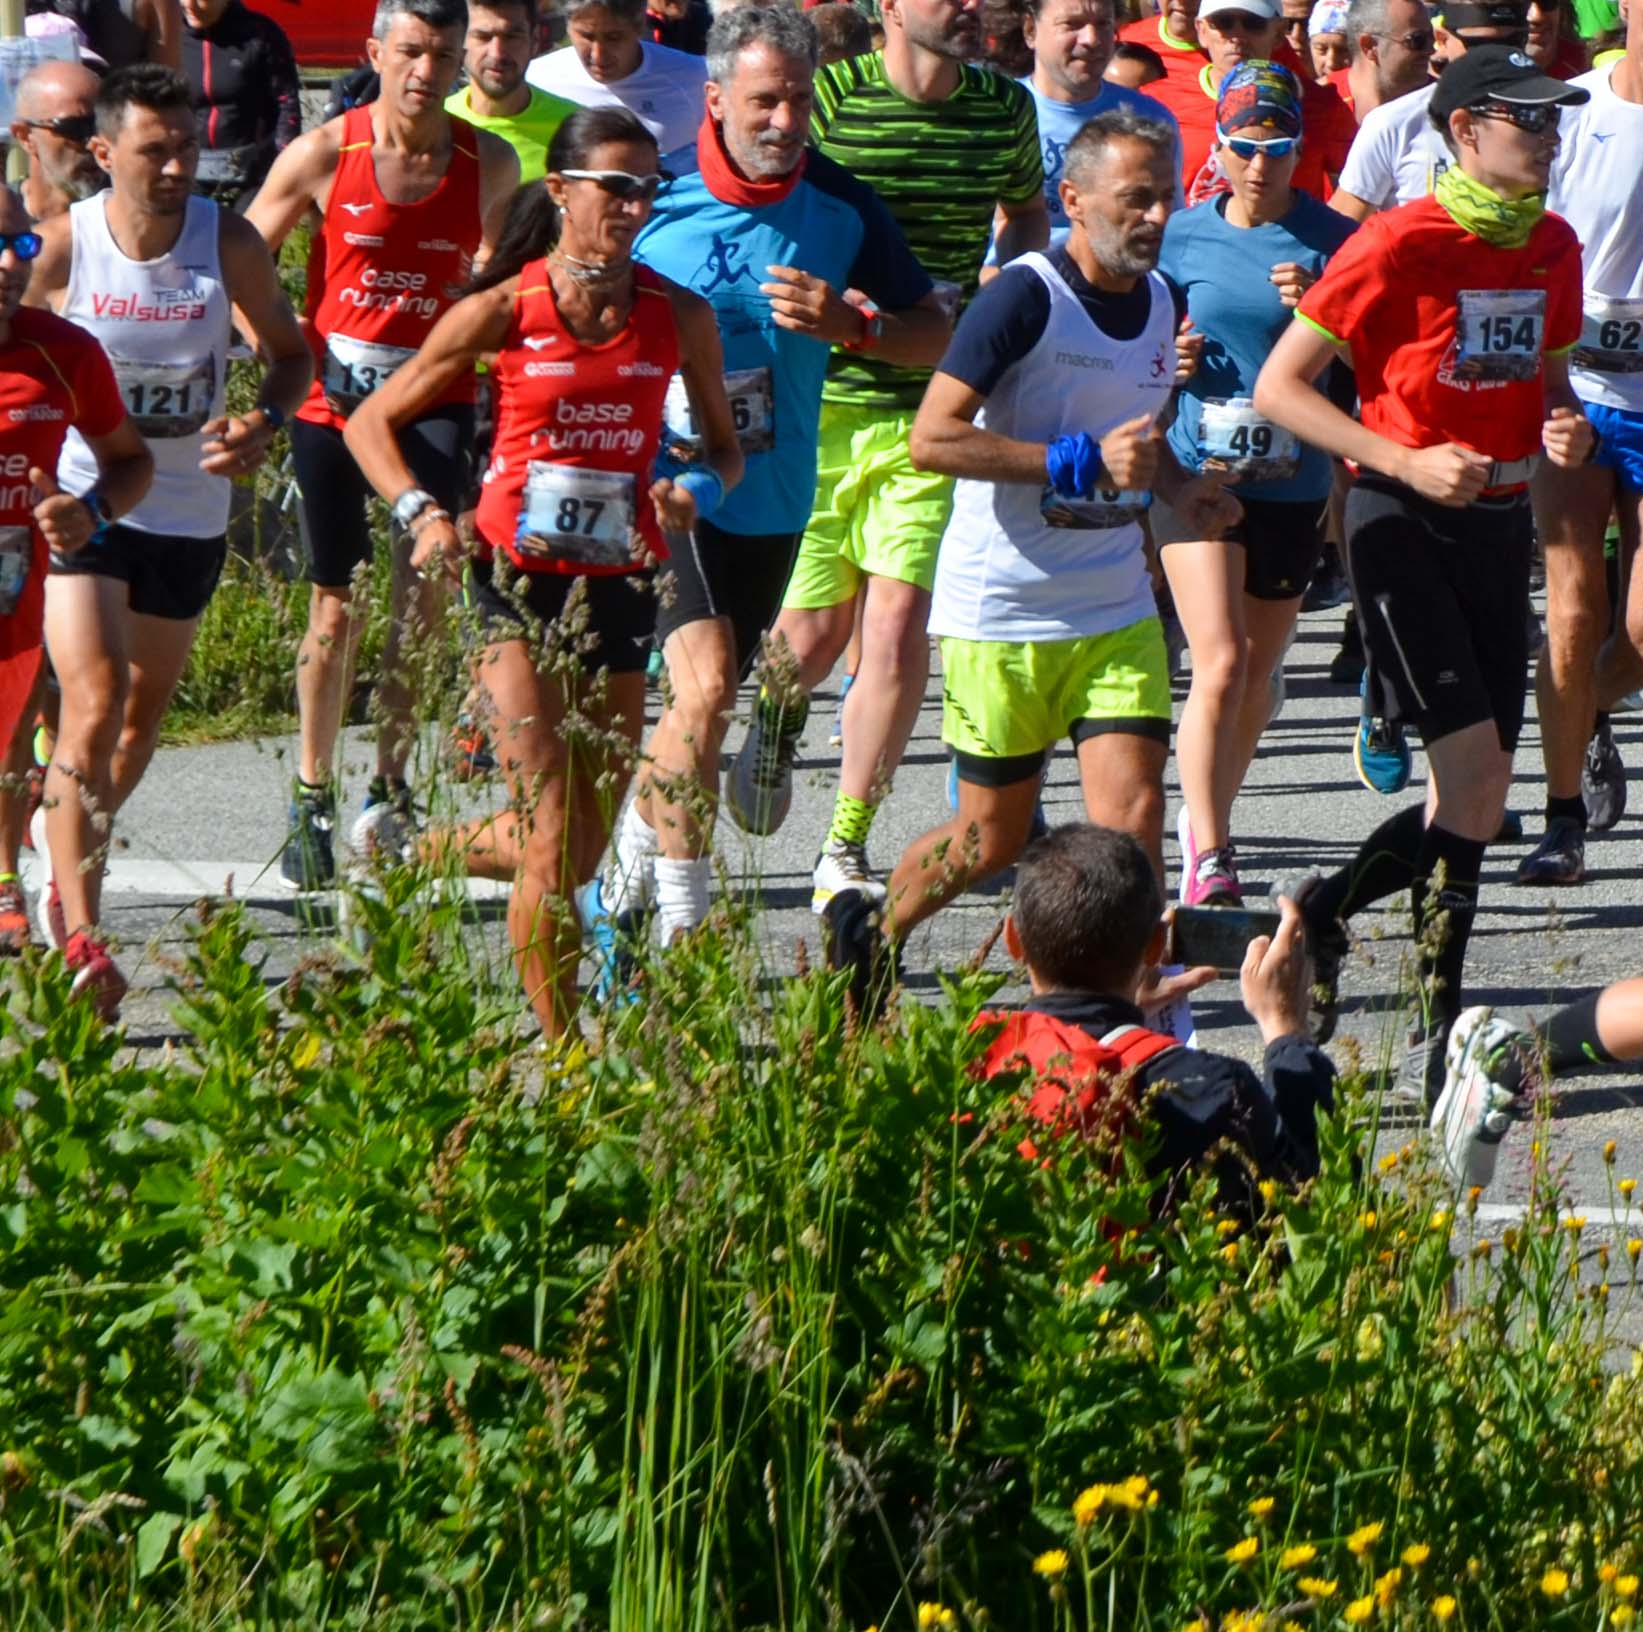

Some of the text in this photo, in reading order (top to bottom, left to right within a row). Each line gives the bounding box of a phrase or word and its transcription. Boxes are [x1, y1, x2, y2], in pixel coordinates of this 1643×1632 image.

[153, 288, 205, 302] TEAM
[1479, 316, 1535, 352] 154
[1599, 319, 1640, 350] 62
[342, 363, 393, 395] 13
[129, 384, 190, 414] 121
[557, 398, 633, 423] base
[531, 427, 645, 455] running
[1229, 425, 1272, 457] 49
[555, 497, 606, 534] 87
